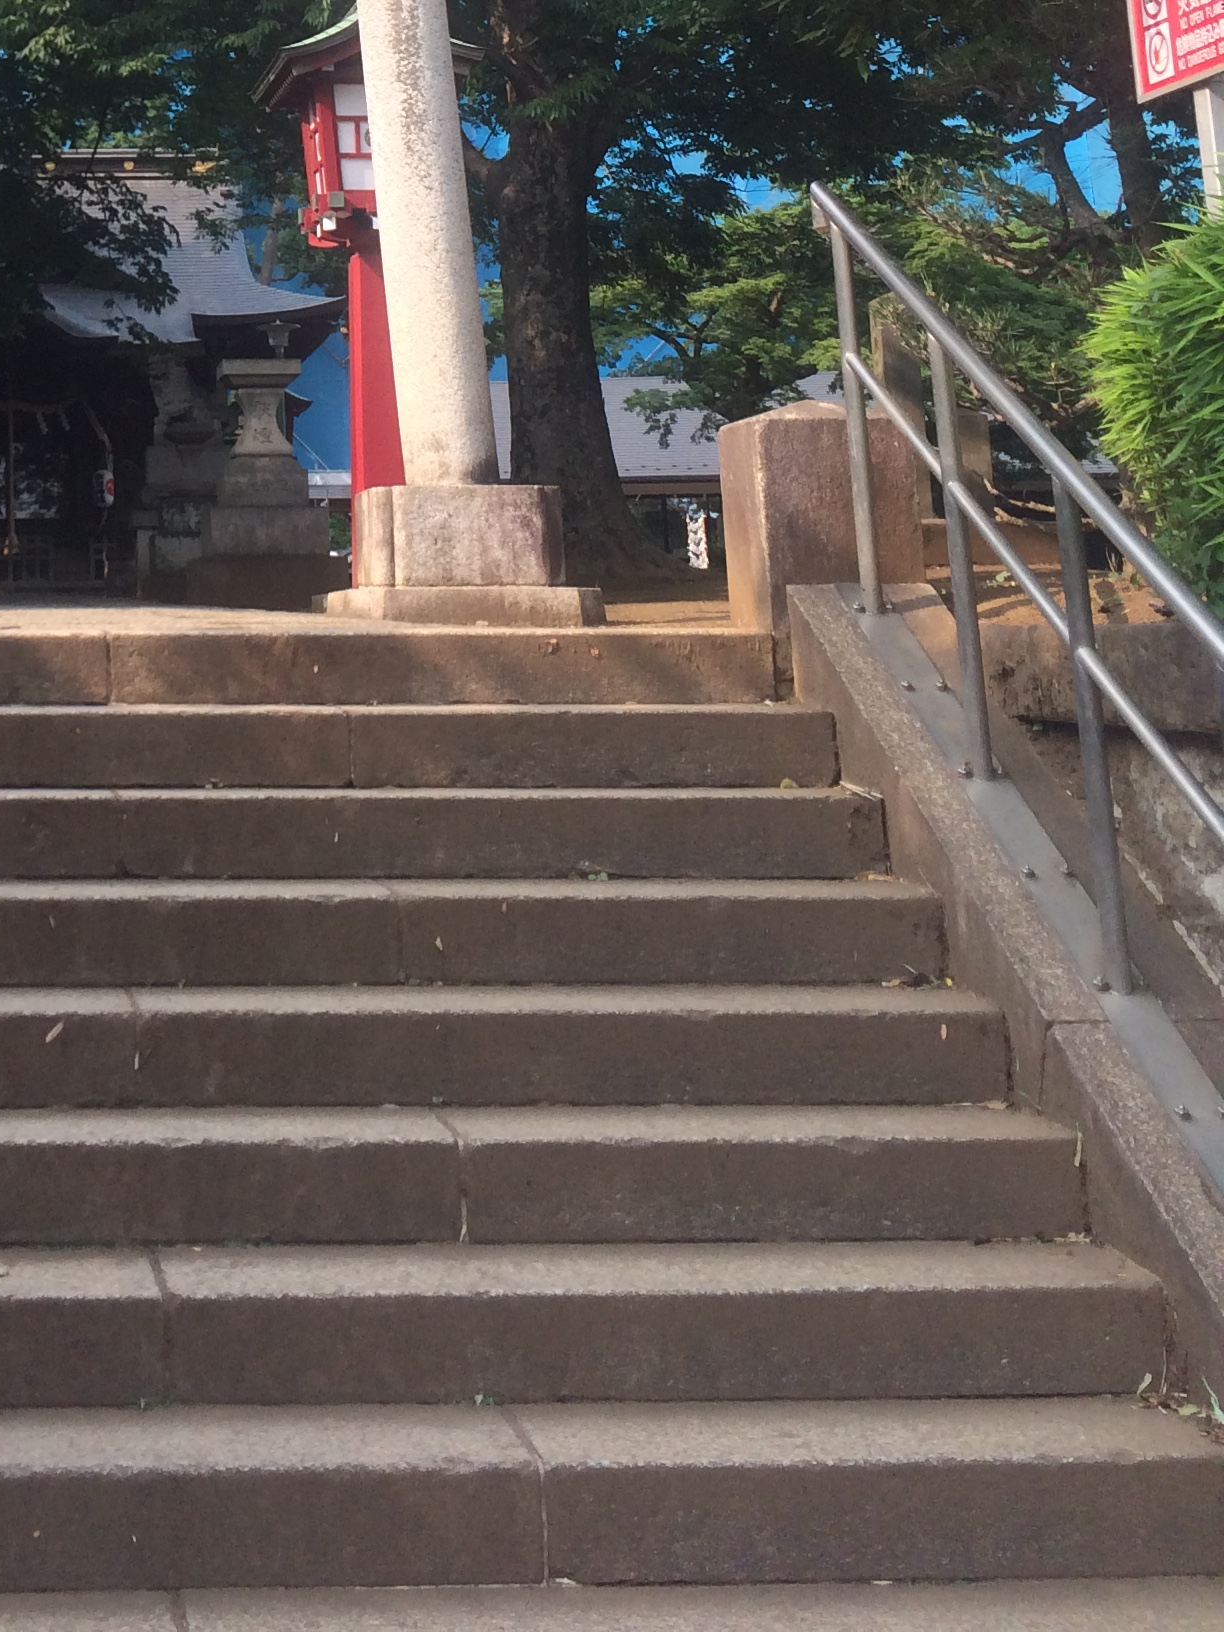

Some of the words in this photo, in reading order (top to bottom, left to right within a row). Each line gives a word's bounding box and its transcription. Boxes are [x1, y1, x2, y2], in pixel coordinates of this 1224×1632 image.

[1179, 17, 1188, 30] NO
[1189, 9, 1204, 26] OPEN
[1178, 57, 1187, 71] NO
